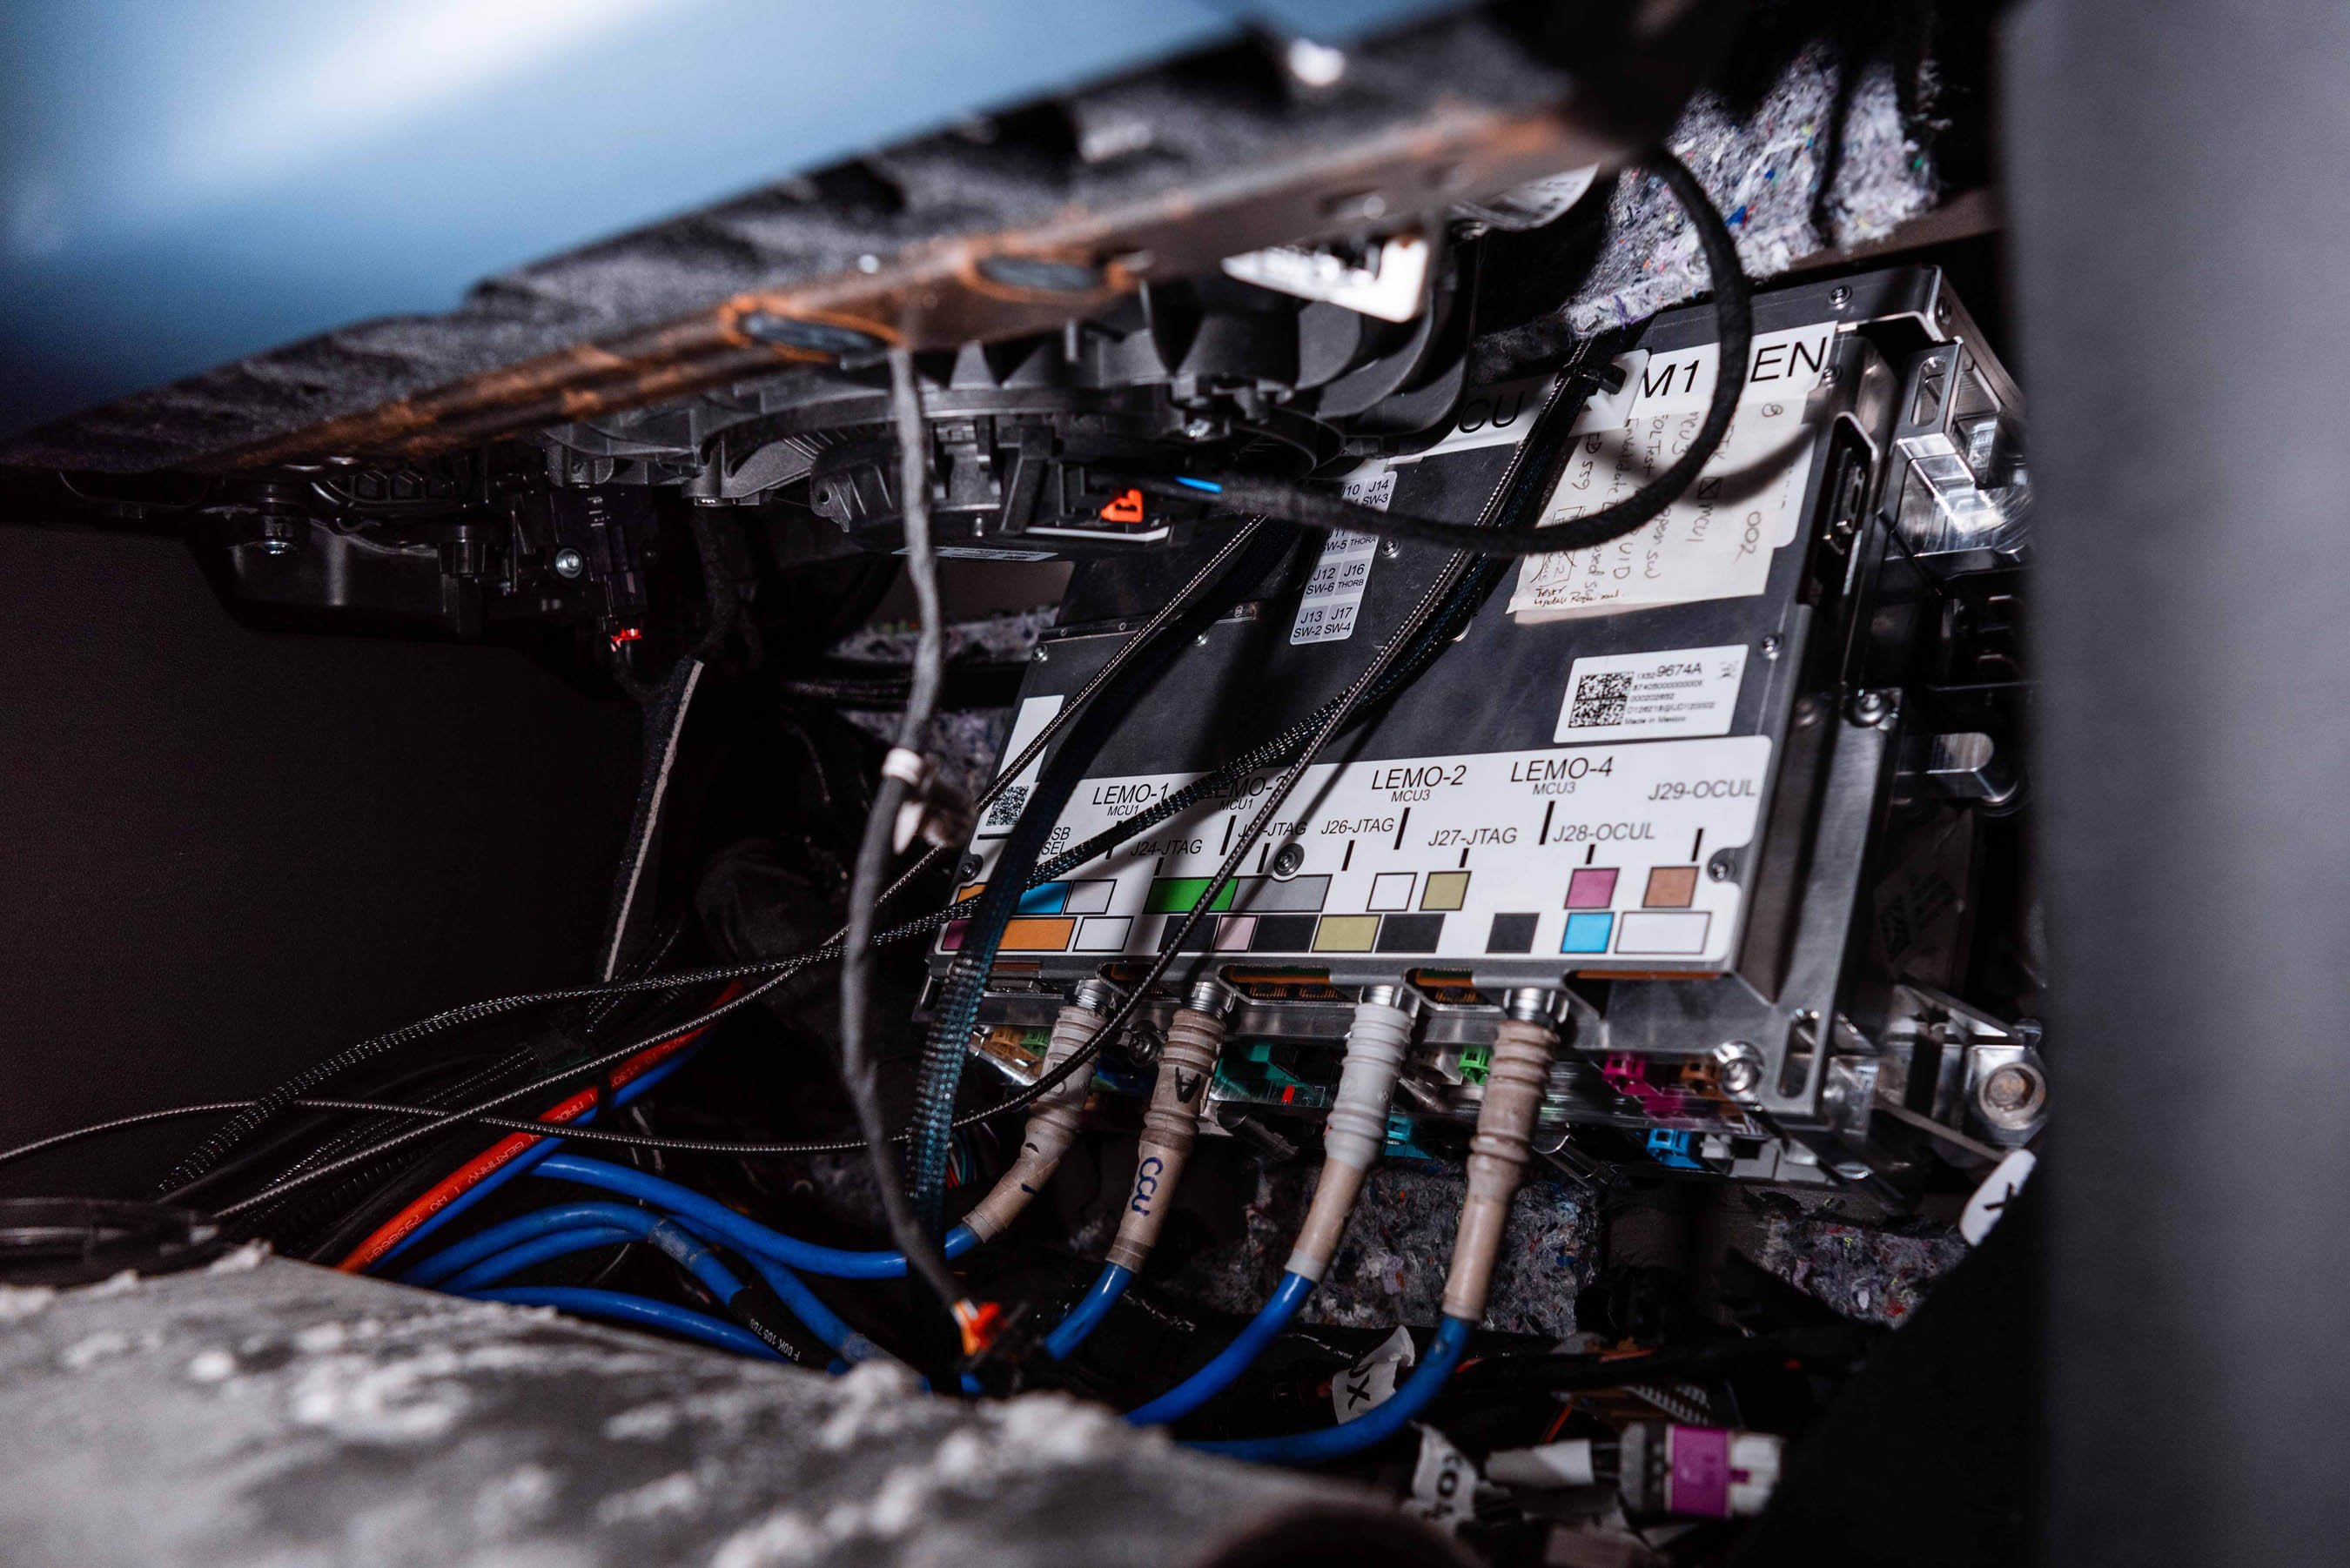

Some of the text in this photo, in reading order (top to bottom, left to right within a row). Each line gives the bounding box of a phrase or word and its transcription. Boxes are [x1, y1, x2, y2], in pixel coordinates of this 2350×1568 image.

[1749, 336, 1828, 384] EN
[1368, 479, 1390, 493] J14
[1362, 493, 1389, 506] SW-3
[1322, 536, 1377, 553] SW-5 THORA
[1313, 563, 1366, 581] J12 J16
[1306, 578, 1365, 595] SW-6 THORB
[1300, 606, 1353, 624] J13 J17
[1293, 622, 1351, 639] SW-2 SW-4
[1371, 764, 1467, 790] LEMO-2
[1510, 755, 1614, 782] LEMO-4
[1092, 782, 1170, 806] LEMO-1
[1210, 775, 1287, 799] EMO-
[1391, 788, 1431, 802] MCU3
[1533, 781, 1576, 795] MCU3
[1648, 779, 1756, 801] J29-OCUL
[1106, 804, 1140, 817] MCU1
[1219, 798, 1254, 811] MCU1
[1238, 821, 1307, 839] J-JTAG
[1320, 817, 1395, 835] J26-JTAG
[1553, 821, 1656, 843] J28-OCUL
[1427, 827, 1518, 847] J27-JTAG
[1131, 839, 1204, 857] J24-JTAG
[467, 1139, 527, 1185] GERMANY
